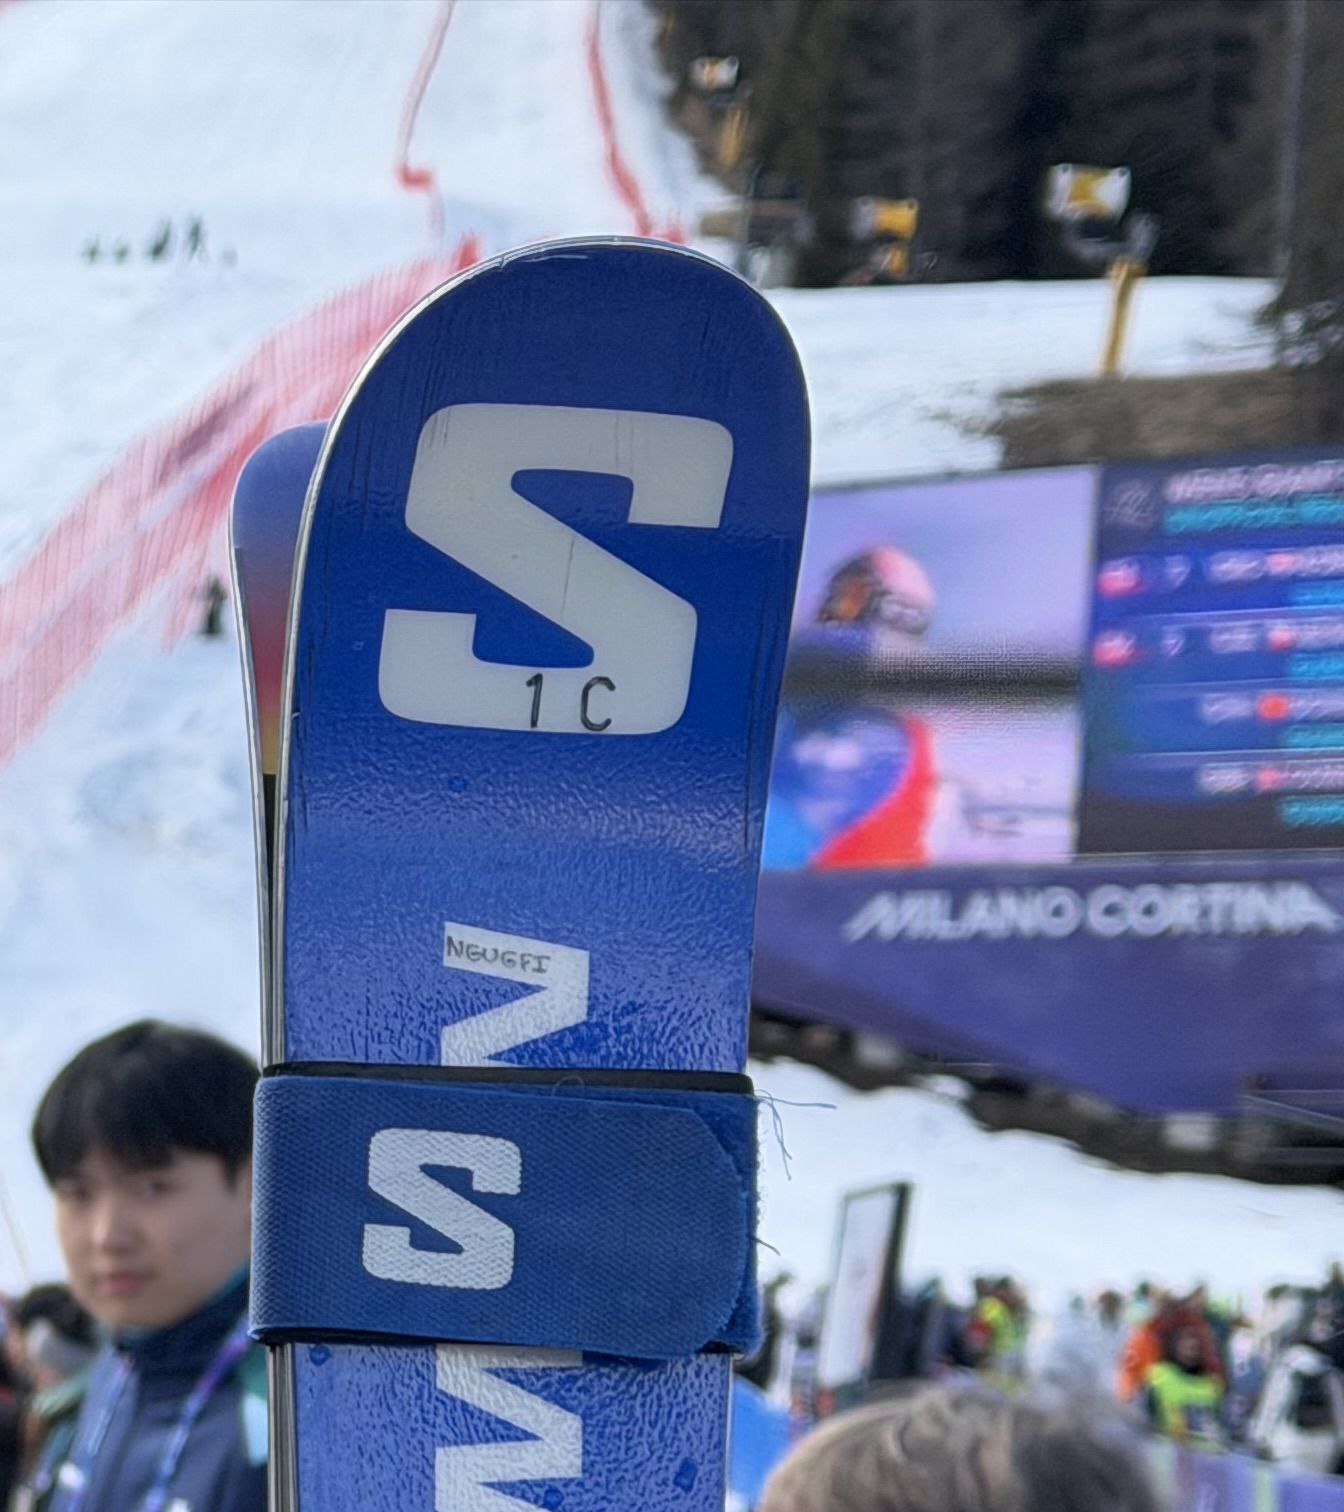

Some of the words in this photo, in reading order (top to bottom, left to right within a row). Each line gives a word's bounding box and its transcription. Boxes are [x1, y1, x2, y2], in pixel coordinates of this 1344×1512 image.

[378, 402, 734, 735] S
[525, 673, 543, 728] 1
[580, 675, 616, 731] C
[845, 889, 1081, 941] MILANO
[1089, 884, 1338, 936] CORTINA
[362, 1128, 522, 1291] S
